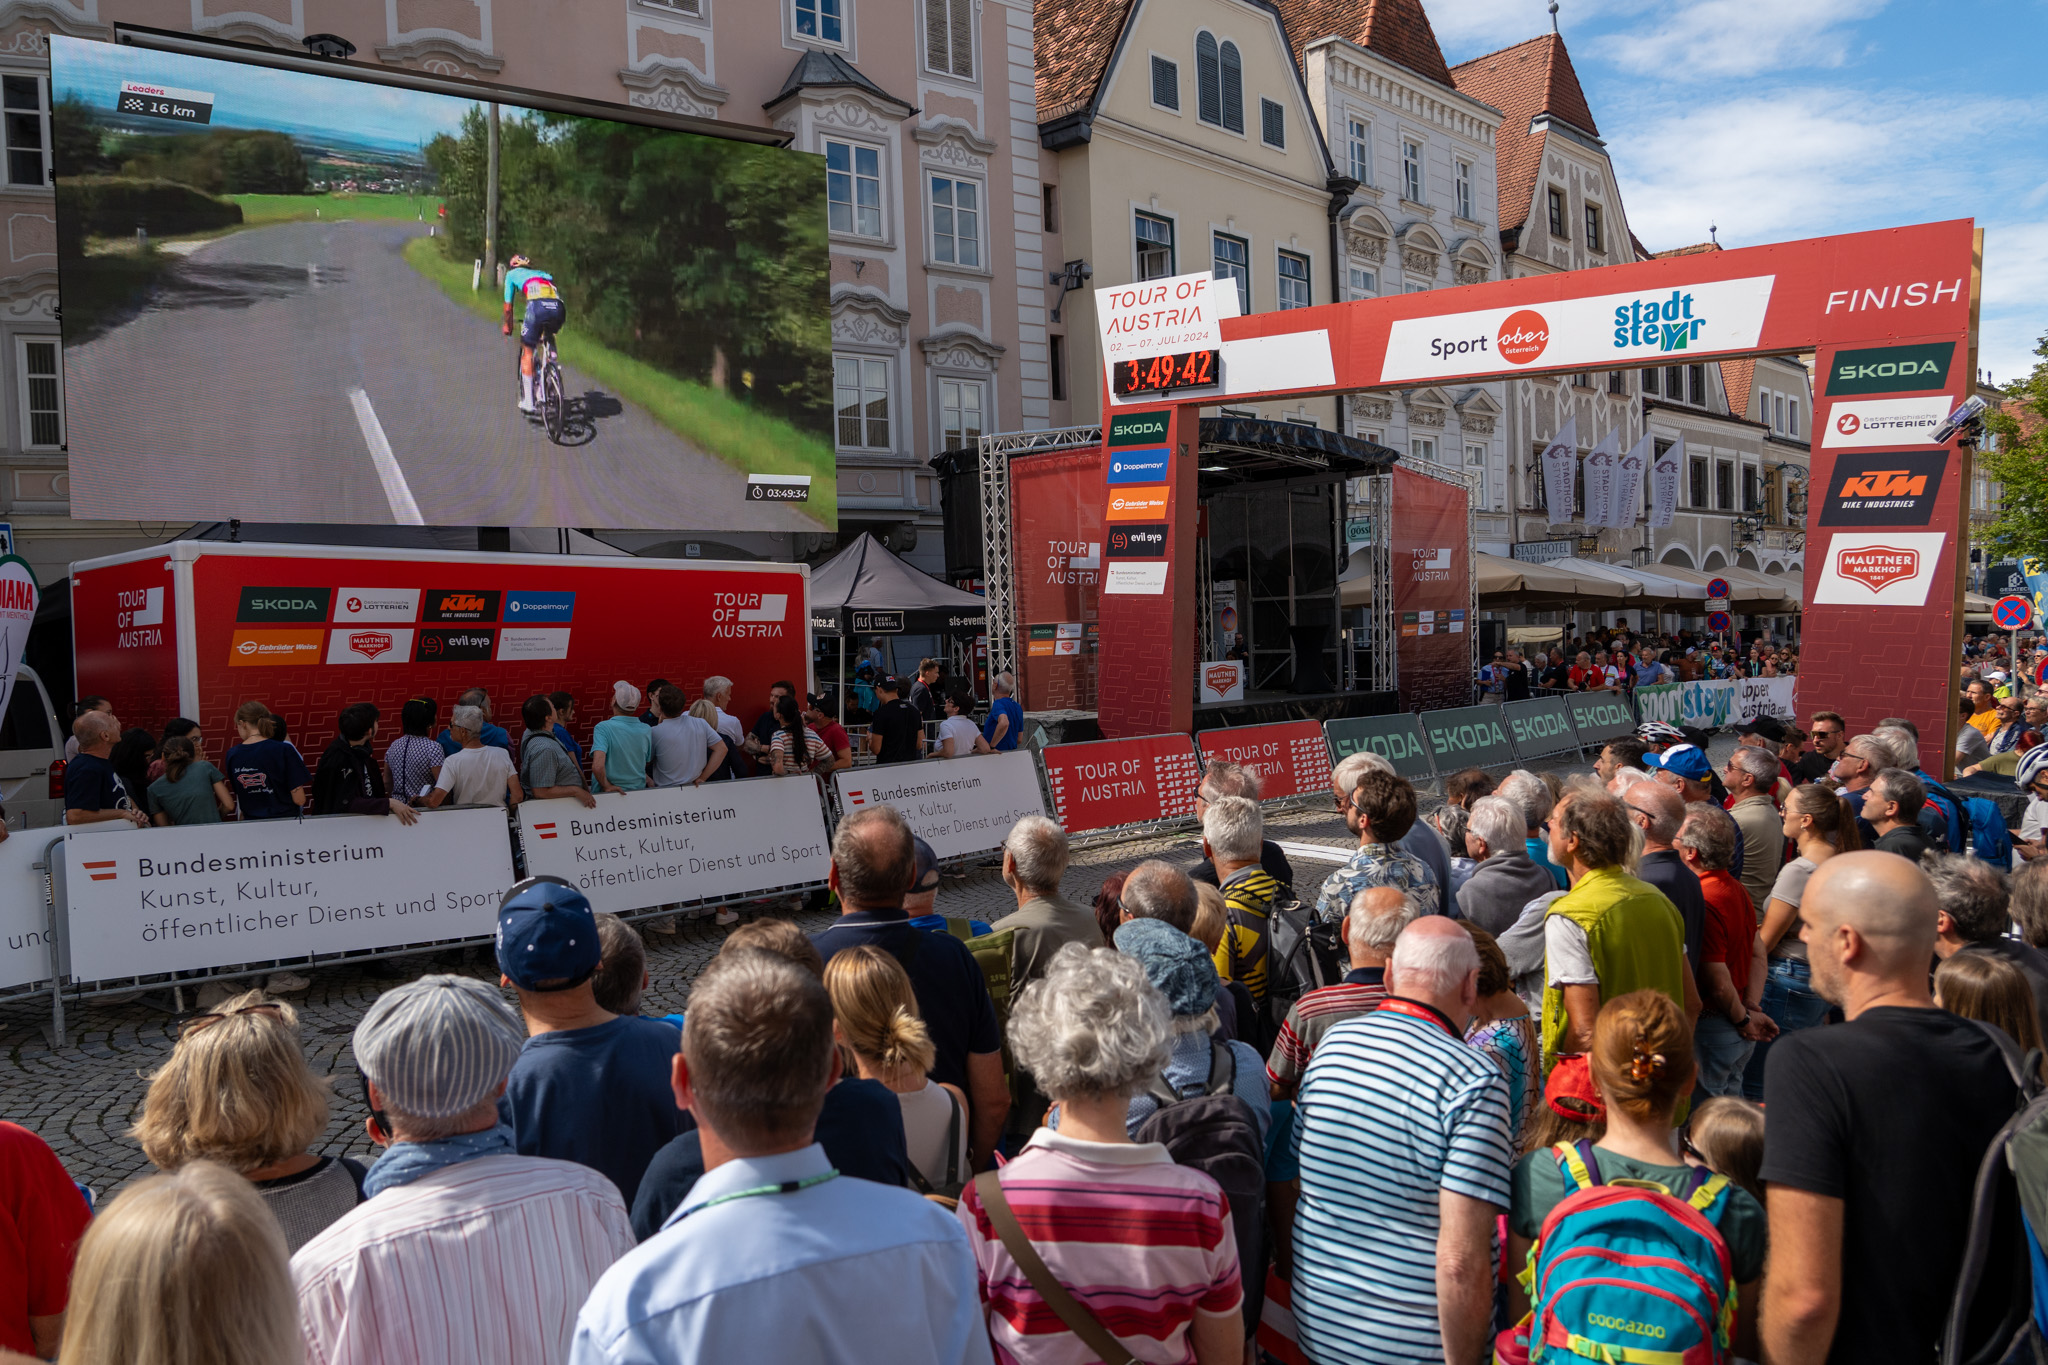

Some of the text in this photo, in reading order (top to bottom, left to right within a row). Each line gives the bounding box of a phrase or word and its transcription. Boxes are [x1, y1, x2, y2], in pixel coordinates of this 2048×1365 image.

[127, 84, 165, 96] Leaders
[149, 102, 196, 118] 16 km
[1109, 279, 1207, 310] TOUR OF
[1825, 278, 1962, 315] FINISH
[1614, 290, 1694, 327] stadt
[1106, 306, 1202, 335] AUSTRIA
[1110, 343, 1124, 352] 02.
[1139, 339, 1154, 348] 07.
[1157, 335, 1181, 346] JULI
[1183, 331, 1209, 342] 2024
[1430, 322, 1550, 360] Sport ober
[1614, 317, 1706, 352] steyr
[1505, 345, 1540, 355] österreich
[1127, 350, 1211, 391] 3:49:42
[1863, 414, 1938, 422] österreichische
[1863, 420, 1937, 430] LOTTERIEN
[1123, 462, 1163, 471] Doppelmayr
[1552, 462, 1561, 495] STYRIA
[1593, 470, 1601, 500] STYRIA
[1838, 470, 1928, 498] KTM
[767, 488, 808, 498] 03:49:34
[1562, 461, 1572, 518] STADTHOTEL
[1600, 469, 1609, 524] STADTHOTEL
[1661, 475, 1675, 526] STADTHOTEL
[1841, 500, 1915, 509] BIKE INDUSTRIES
[1131, 532, 1146, 542] evil
[1048, 541, 1087, 554] TOUR
[1411, 548, 1437, 559] TOUR
[1516, 542, 1569, 556] STADTHOTEL
[1047, 556, 1067, 569] OF
[1412, 560, 1424, 570] OF
[1844, 555, 1912, 565] MAUTNER
[1046, 572, 1100, 585] AUSTRI
[1411, 571, 1450, 582] AUSTRIA
[0, 579, 33, 611] IANA
[118, 589, 145, 608] TOUR
[440, 594, 486, 611] KTM
[713, 592, 760, 606] TOUR
[522, 603, 570, 611] Doppelmayr
[712, 608, 735, 622] OF
[118, 611, 131, 628] OF
[118, 628, 163, 648] AUSTRIA
[448, 635, 469, 646] evil
[711, 624, 784, 638] AUSTRIA
[1208, 670, 1236, 679] MAUTNER
[1639, 682, 1735, 726] sport steyr
[1224, 742, 1280, 761] TOUR OF
[1075, 759, 1141, 781] TOUR OF
[872, 777, 982, 802] Bundesministerium
[1081, 780, 1146, 802] AUSTRIA
[918, 801, 957, 817] Kultur,
[570, 807, 736, 836] Bundesministerium
[953, 816, 989, 833] Dienst
[992, 812, 1011, 827] und
[575, 836, 695, 863] Kunst, Kultur,
[139, 844, 384, 877] Bundesministerium
[579, 843, 823, 889] öffentlicher Dienst und Sport
[141, 878, 318, 910] Kunst, Kultur,
[142, 889, 504, 942] öffentlicher Dienst und Sport
[1587, 1312, 1666, 1339] coocazoo
